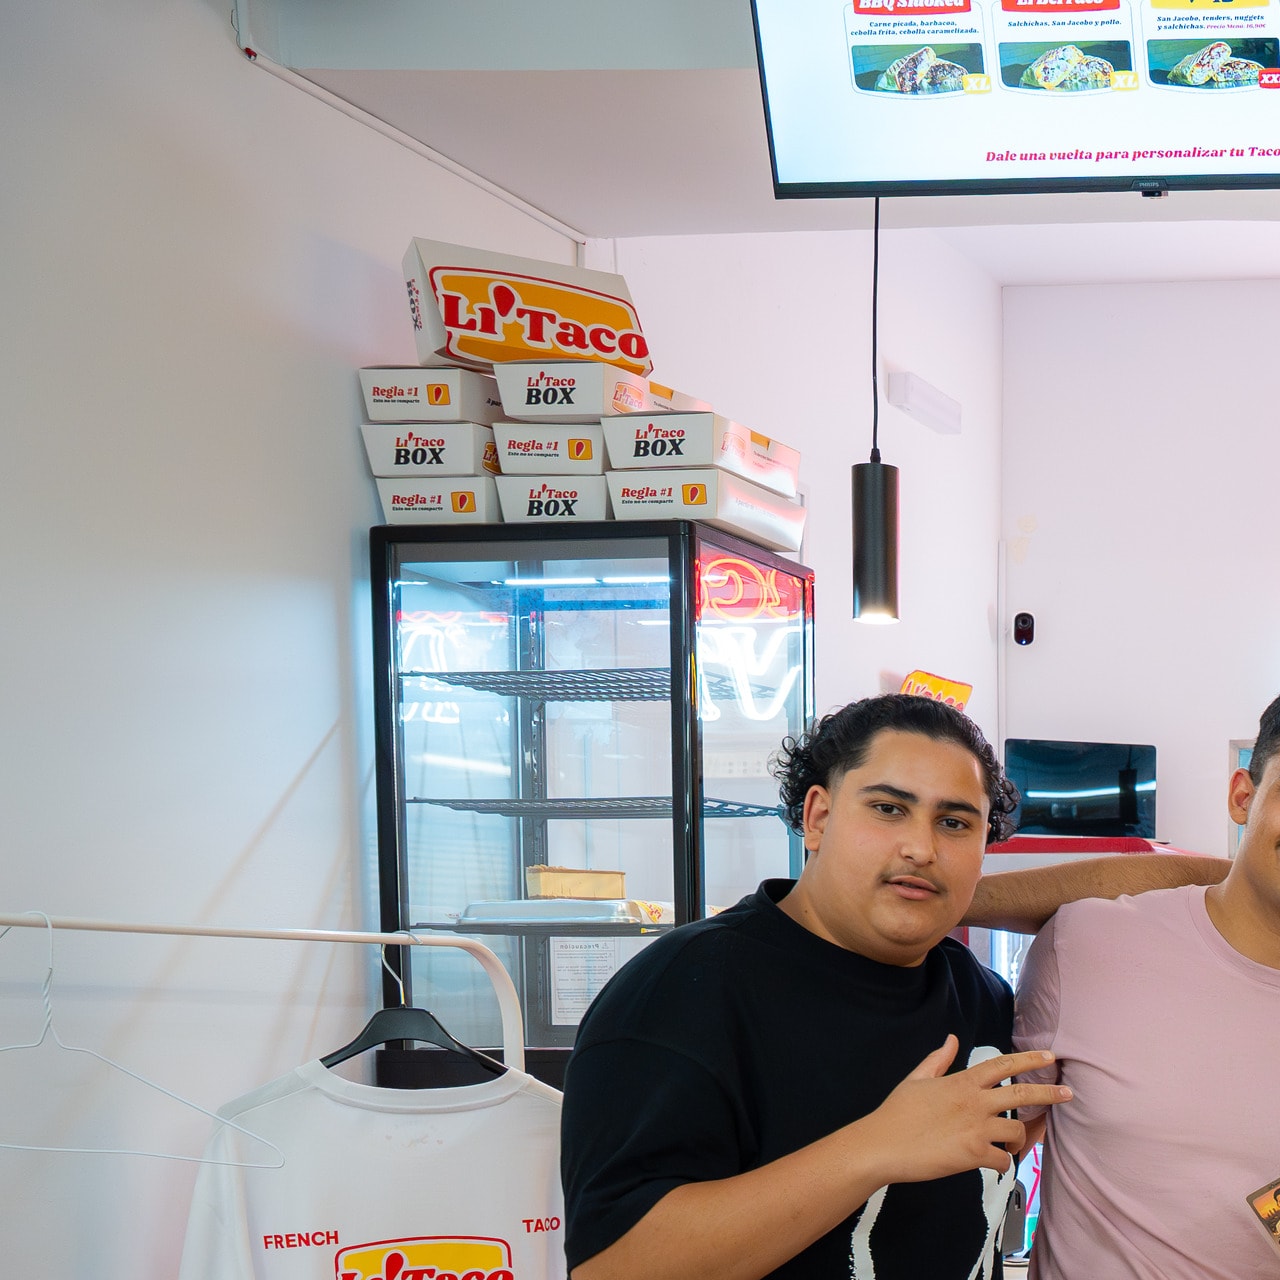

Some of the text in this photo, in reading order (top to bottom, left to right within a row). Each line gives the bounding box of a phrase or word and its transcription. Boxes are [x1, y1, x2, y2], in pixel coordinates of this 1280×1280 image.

[965, 76, 991, 91] XL
[1112, 74, 1137, 90] XL
[986, 150, 1017, 162] Dale
[1020, 152, 1046, 161] una
[1049, 149, 1092, 161] vuelta
[1095, 151, 1129, 162] para
[1132, 147, 1227, 161] personalizar
[1229, 148, 1245, 157] tu
[372, 386, 418, 399] Regla #1
[525, 387, 577, 405] BOX
[507, 440, 559, 453] Regla #1
[633, 438, 686, 458] BOX
[394, 448, 446, 465] BOX
[392, 494, 442, 507] Regla #1
[621, 487, 673, 500] Regla #1
[527, 499, 578, 517] BOX
[263, 1216, 560, 1250] FRENCH TACO
